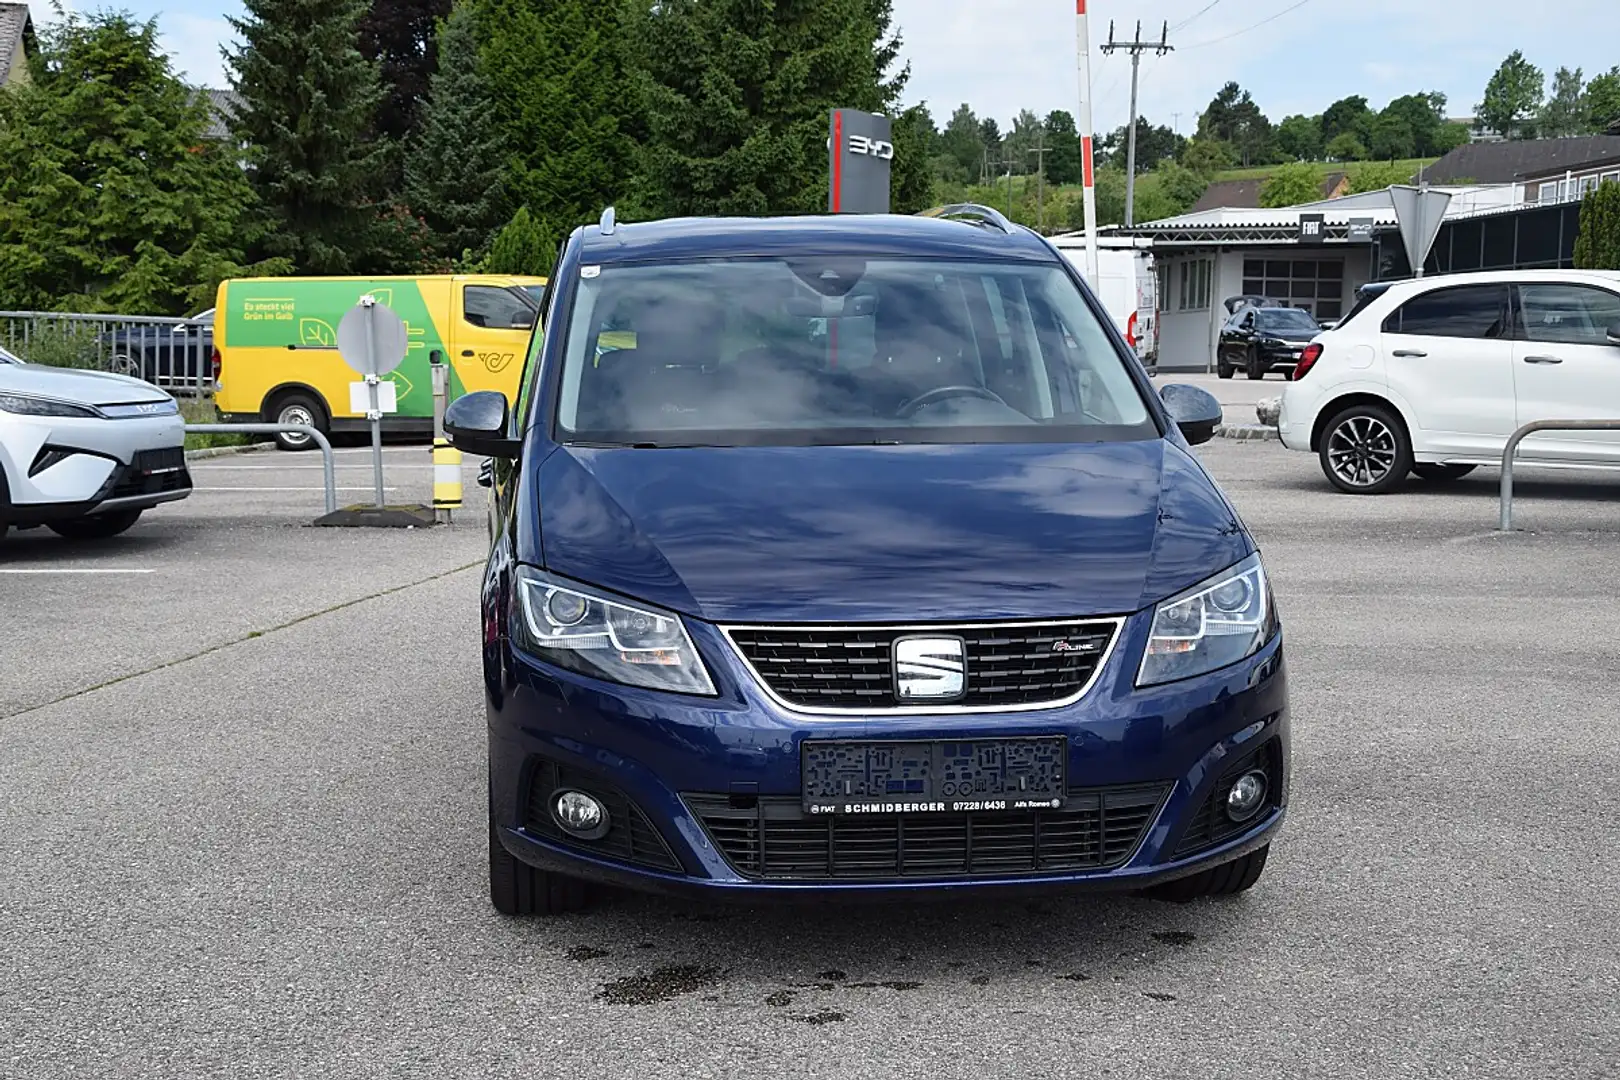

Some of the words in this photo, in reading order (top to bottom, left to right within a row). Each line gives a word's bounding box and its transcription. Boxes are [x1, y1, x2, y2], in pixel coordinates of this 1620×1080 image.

[849, 135, 893, 159] BYD
[1302, 221, 1320, 235] FIAT
[281, 303, 295, 311] viel
[820, 805, 836, 813] FIAT
[845, 802, 945, 812] SCHMIDBERGER
